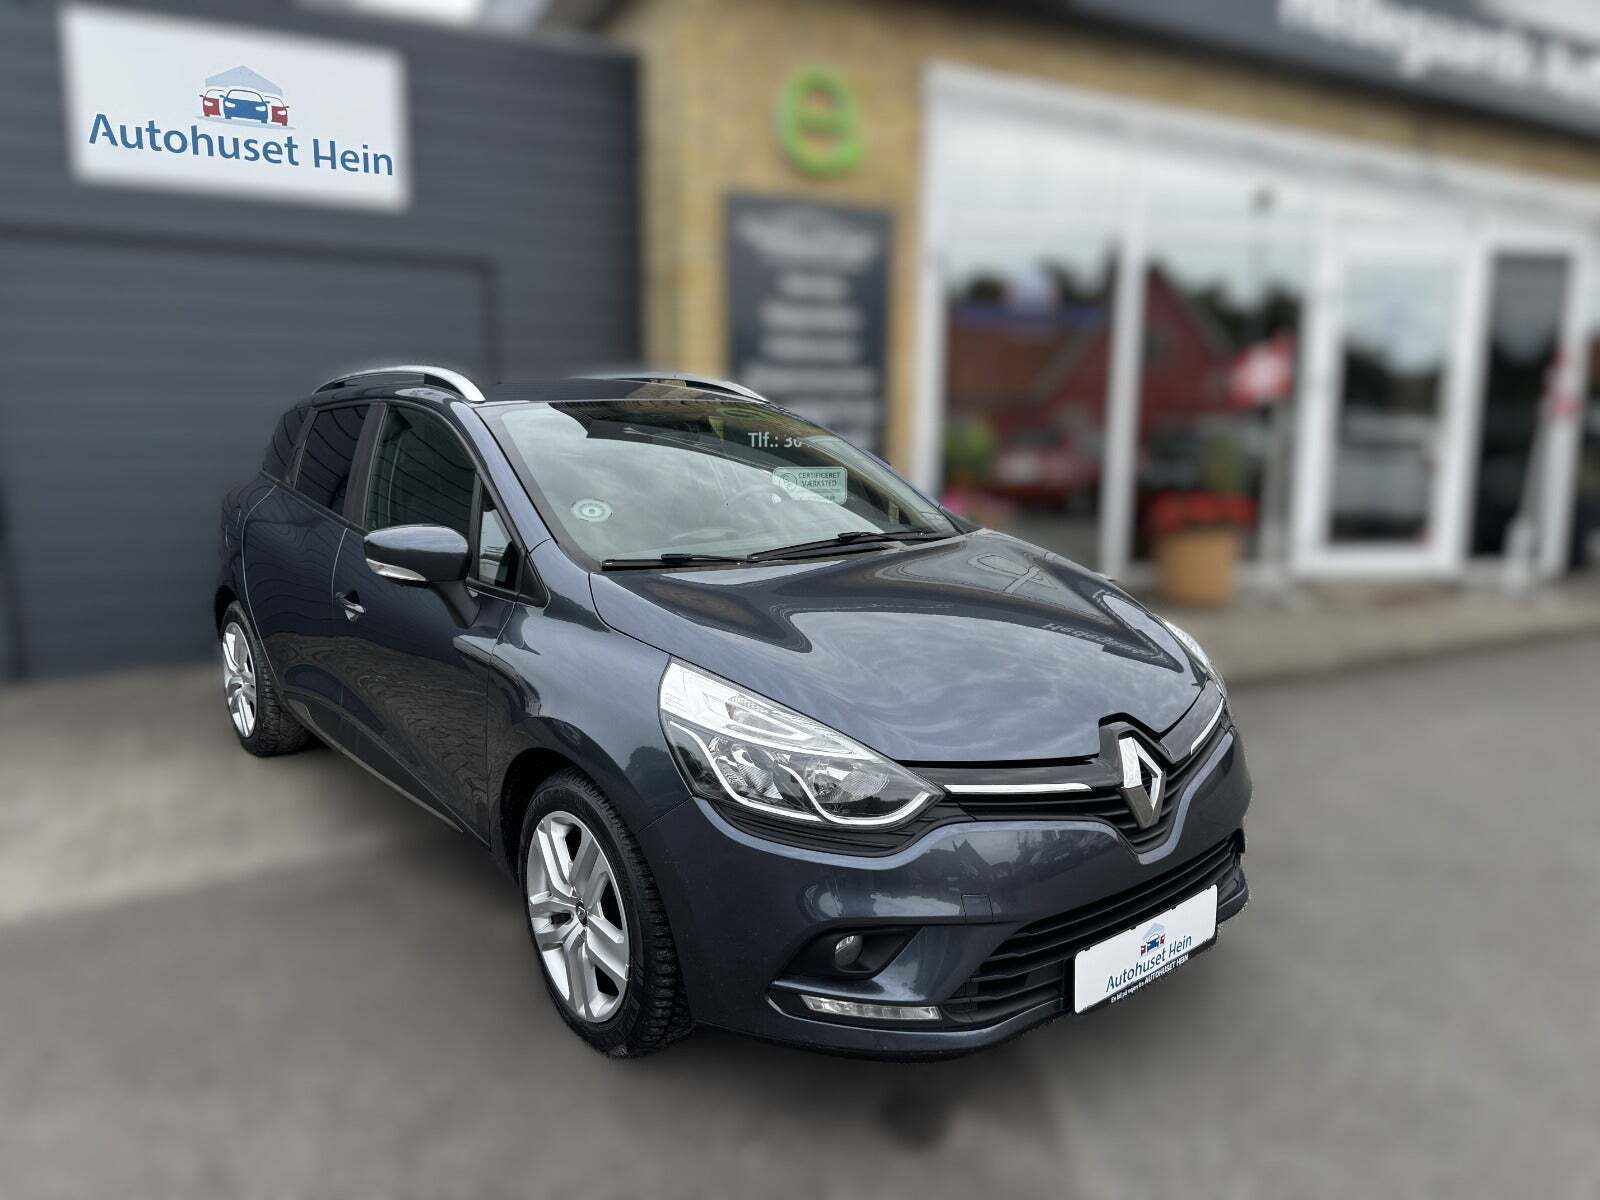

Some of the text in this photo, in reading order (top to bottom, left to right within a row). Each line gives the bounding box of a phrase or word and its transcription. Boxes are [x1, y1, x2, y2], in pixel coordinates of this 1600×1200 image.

[89, 113, 394, 176] Autohuset Hein
[747, 431, 779, 448] Tlf.:
[801, 479, 838, 487] VÆRKSTED
[1105, 935, 1192, 993] Autohuset Hein
